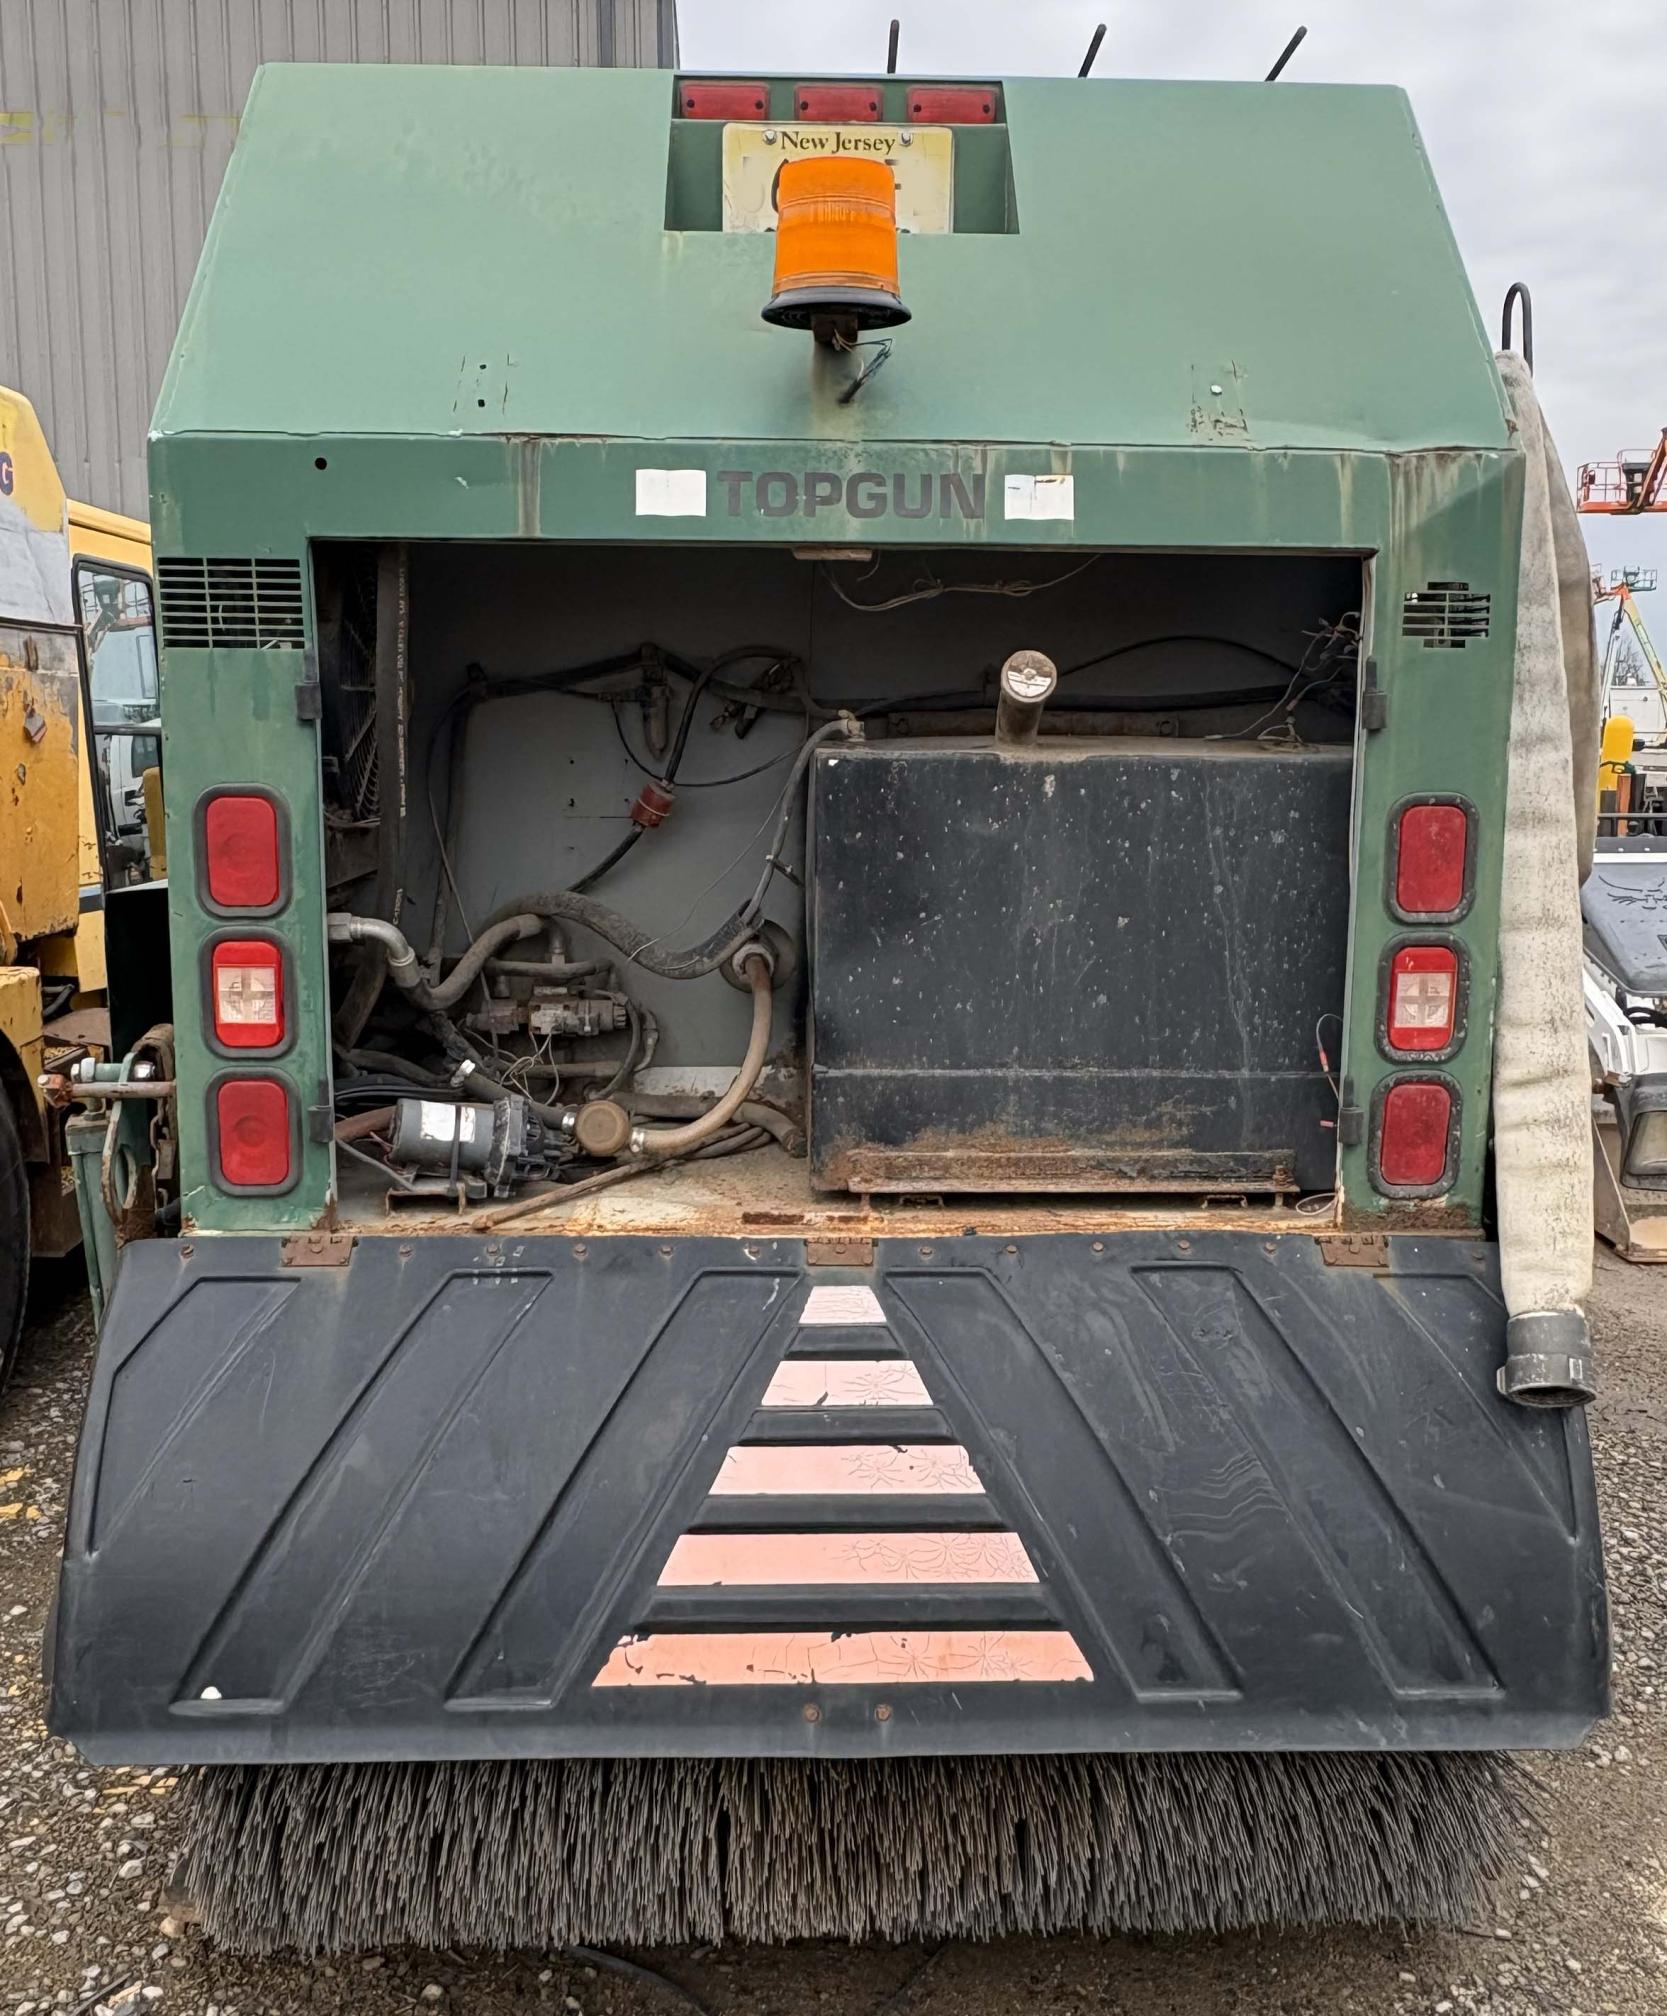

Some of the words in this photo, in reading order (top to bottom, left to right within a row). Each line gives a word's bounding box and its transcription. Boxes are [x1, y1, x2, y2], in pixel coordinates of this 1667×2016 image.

[780, 131, 829, 151] New
[831, 132, 896, 155] Jersey
[716, 470, 986, 519] TOPGUN
